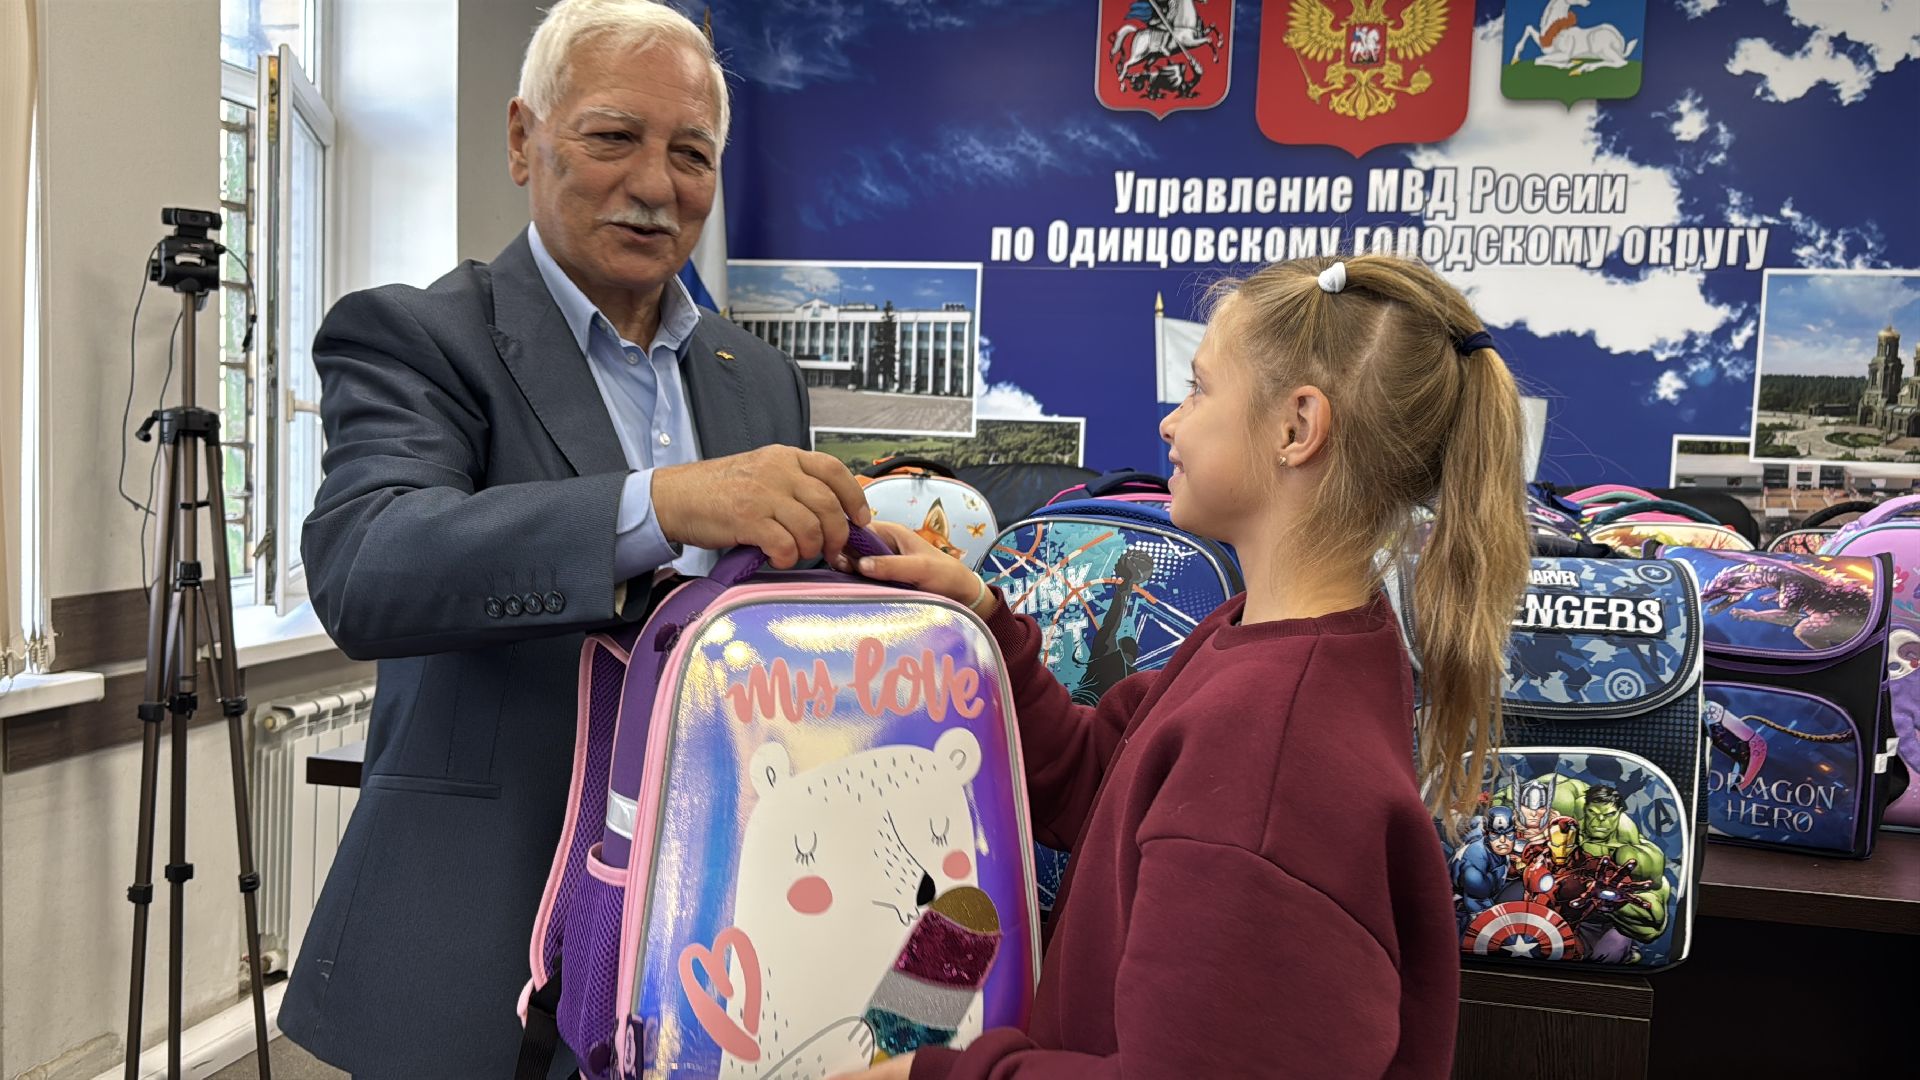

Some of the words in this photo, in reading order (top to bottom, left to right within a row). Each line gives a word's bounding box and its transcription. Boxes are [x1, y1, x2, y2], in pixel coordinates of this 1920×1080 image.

[1114, 170, 1353, 218] Управление
[1367, 167, 1458, 220] МВД
[1470, 167, 1629, 214] России
[991, 226, 1035, 262] по
[1046, 219, 1342, 269] Одинцовскому
[1353, 225, 1610, 271] городскому
[1622, 226, 1769, 271] округу
[724, 656, 839, 724] my
[847, 636, 985, 723] love
[1708, 769, 1836, 810] DRAGON
[1726, 799, 1814, 833] HERO
